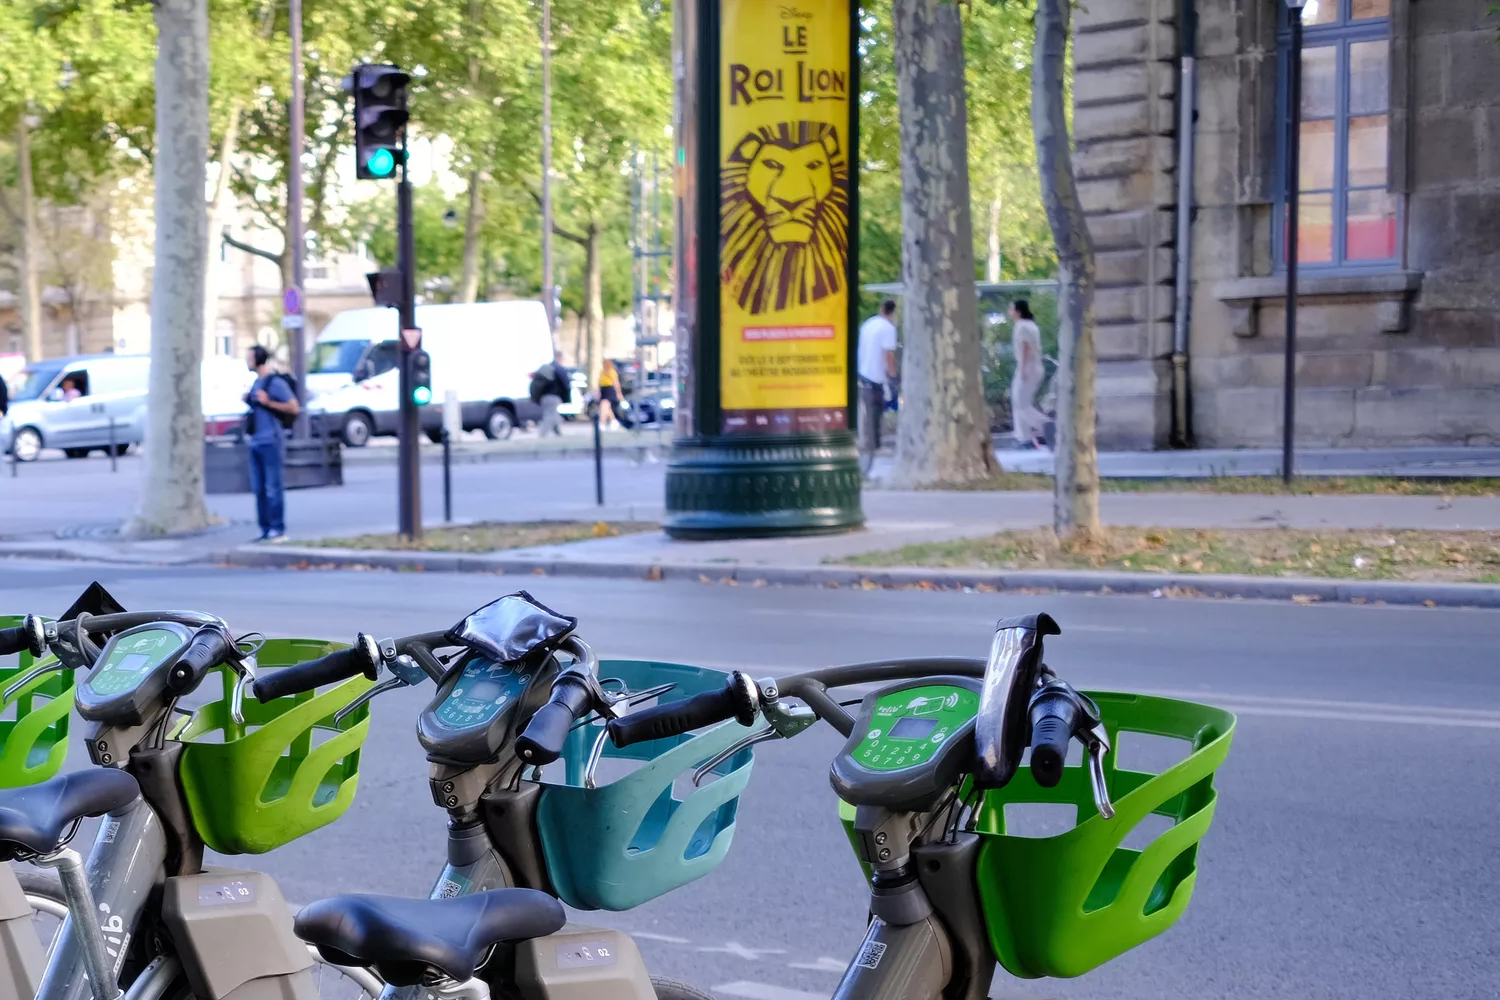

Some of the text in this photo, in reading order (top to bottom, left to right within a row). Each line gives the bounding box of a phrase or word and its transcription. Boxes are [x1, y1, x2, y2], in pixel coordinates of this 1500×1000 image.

[783, 25, 808, 47] LE
[728, 60, 847, 106] ROI LION
[881, 744, 888, 752] 1
[891, 747, 900, 755] 2
[904, 746, 913, 754] 3
[919, 743, 928, 751] 4
[863, 749, 921, 765] 5 6 7 8 9
[238, 887, 250, 896] 03
[597, 948, 610, 957] 02
